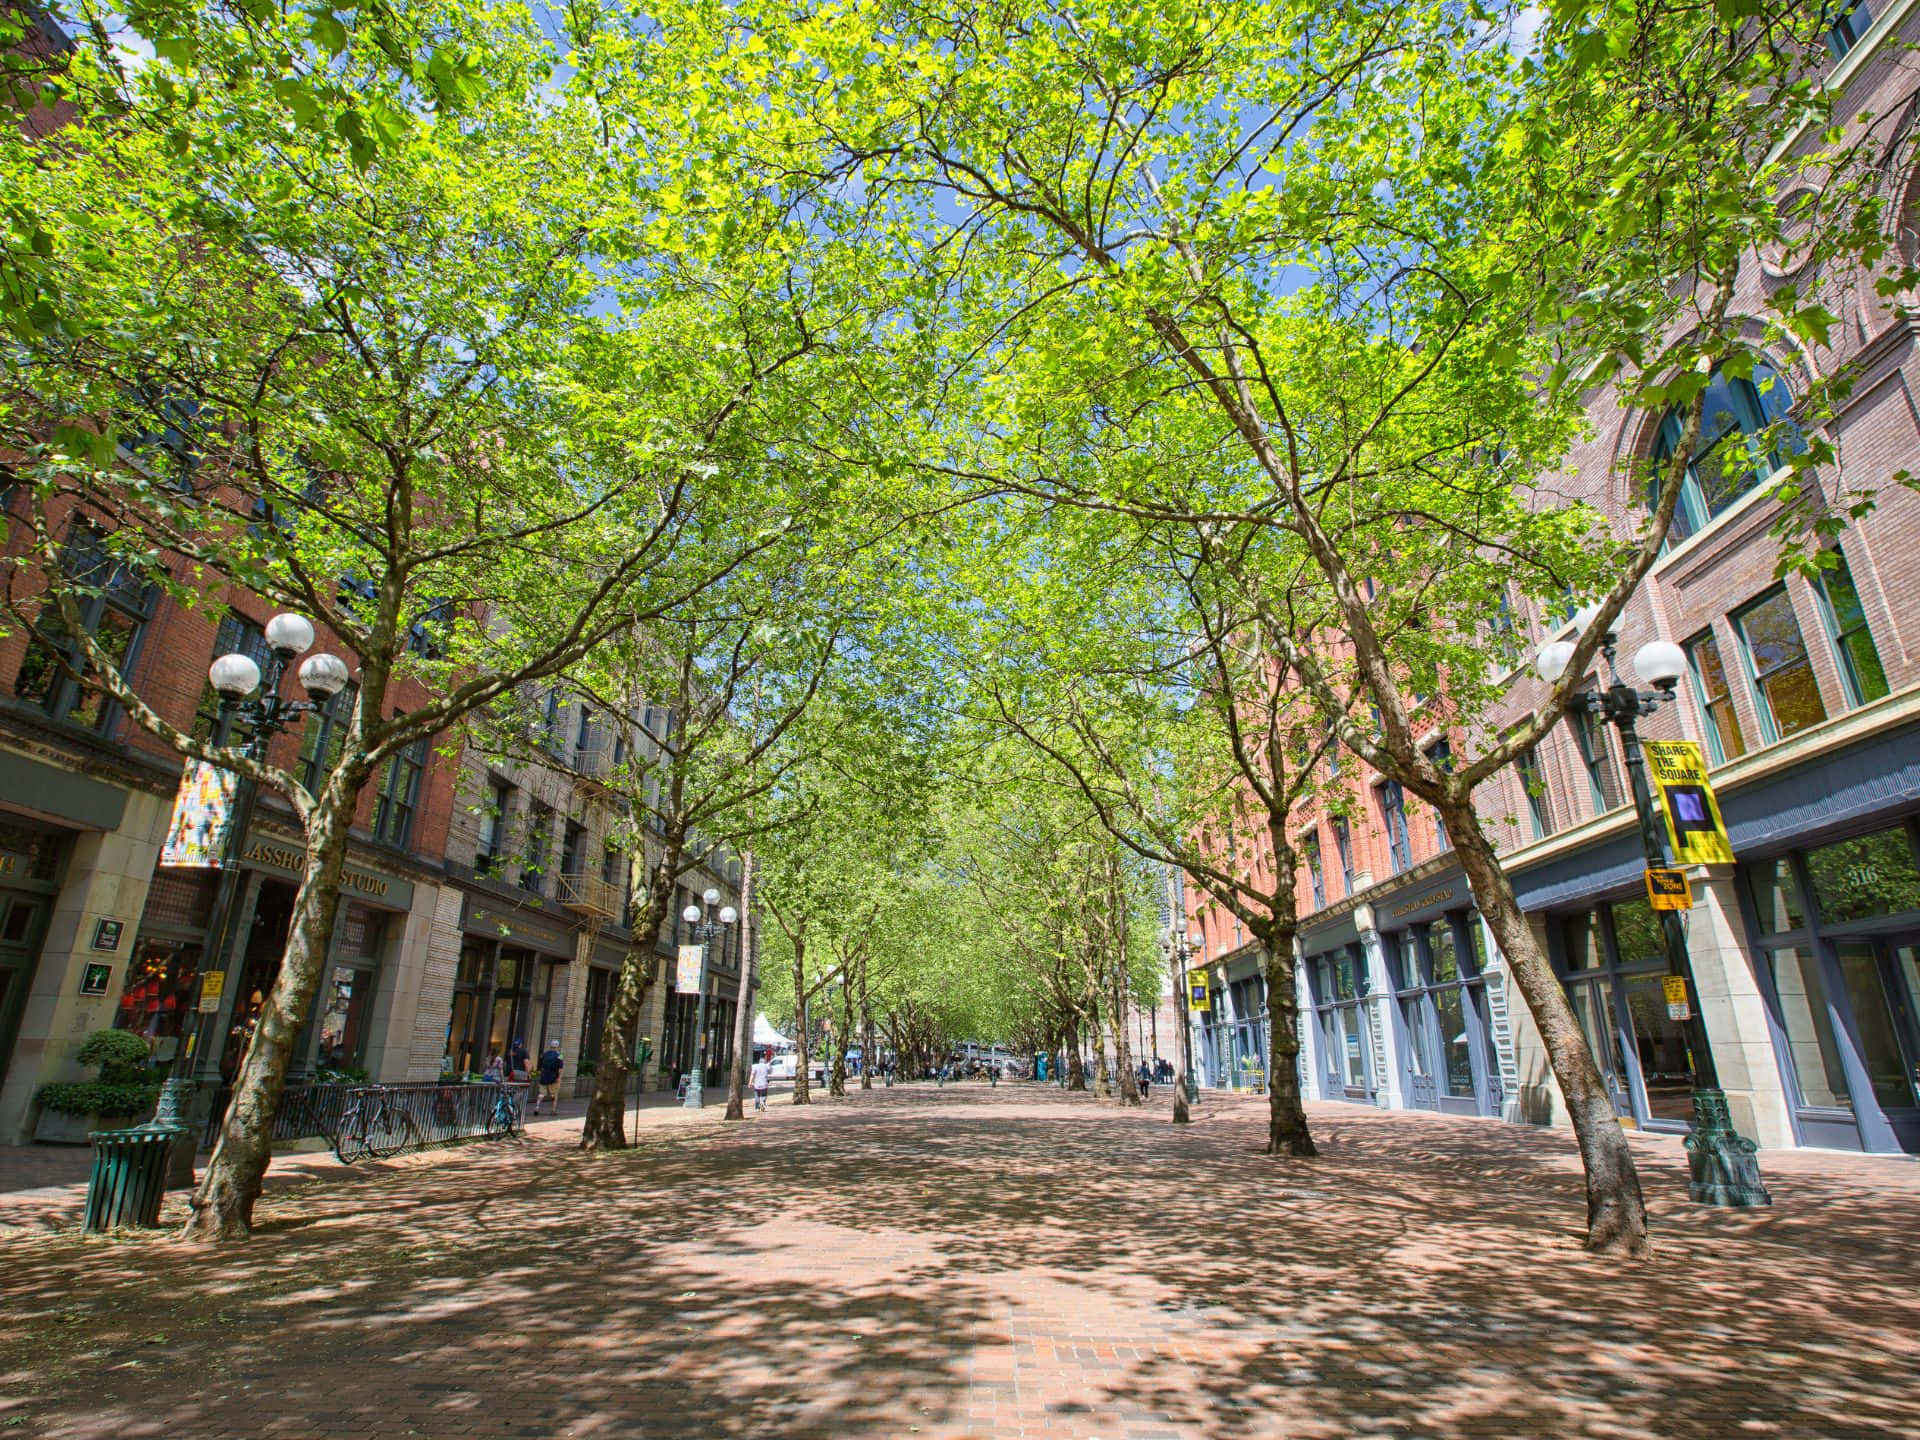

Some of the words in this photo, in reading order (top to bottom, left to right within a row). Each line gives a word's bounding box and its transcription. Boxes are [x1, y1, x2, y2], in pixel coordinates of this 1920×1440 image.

[1651, 745, 1687, 756] SHARE
[1656, 757, 1676, 767] THE
[1660, 769, 1701, 780] SQUARE
[1848, 865, 1878, 887] 316
[338, 869, 388, 896] STUDIO
